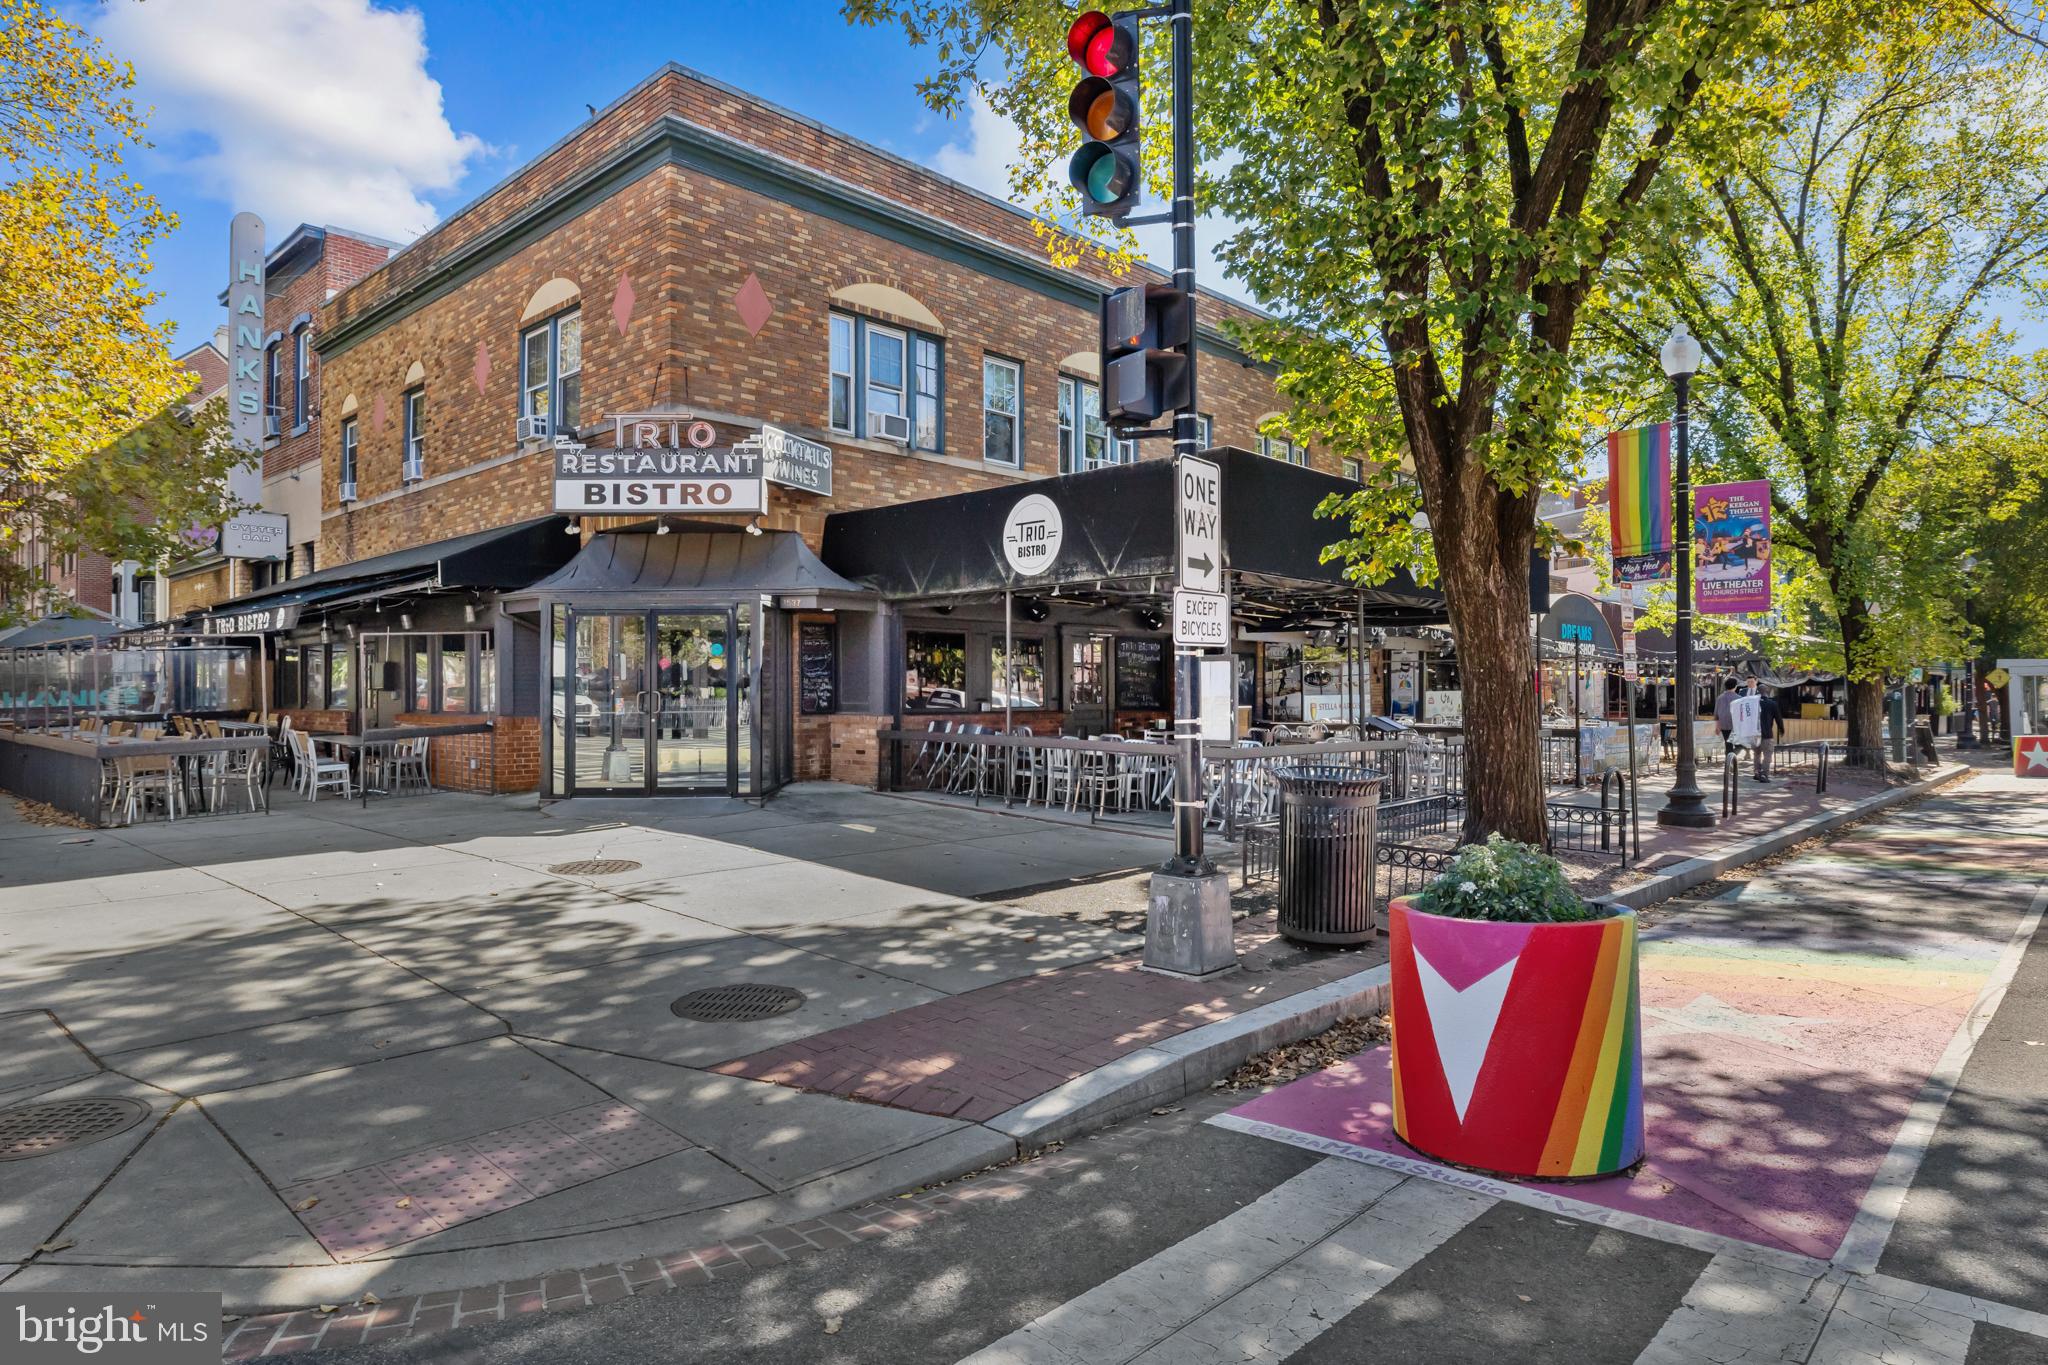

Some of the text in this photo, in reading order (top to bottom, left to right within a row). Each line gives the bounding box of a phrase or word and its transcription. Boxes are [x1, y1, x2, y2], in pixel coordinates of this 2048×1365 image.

[238, 259, 262, 414] HANKS
[602, 412, 716, 449] TRIO
[562, 454, 758, 474] RESTAURANT
[583, 483, 733, 505] BISTRO
[1184, 473, 1217, 506] ONE
[1729, 501, 1760, 509] KEEGAN
[230, 523, 283, 534] OYSTER
[1015, 520, 1046, 543] TRIO
[1184, 508, 1217, 540] WAY
[242, 534, 271, 543] BAR
[1018, 544, 1046, 558] BISTRO
[1621, 560, 1660, 574] High Heel
[1702, 580, 1764, 590] LIVE THEATER
[1186, 600, 1218, 616] EXCEPT
[238, 611, 270, 632] BISTRO
[1181, 621, 1222, 637] BICYCLES
[1561, 623, 1593, 640] DREAMS
[1579, 643, 1595, 656] SHOP
